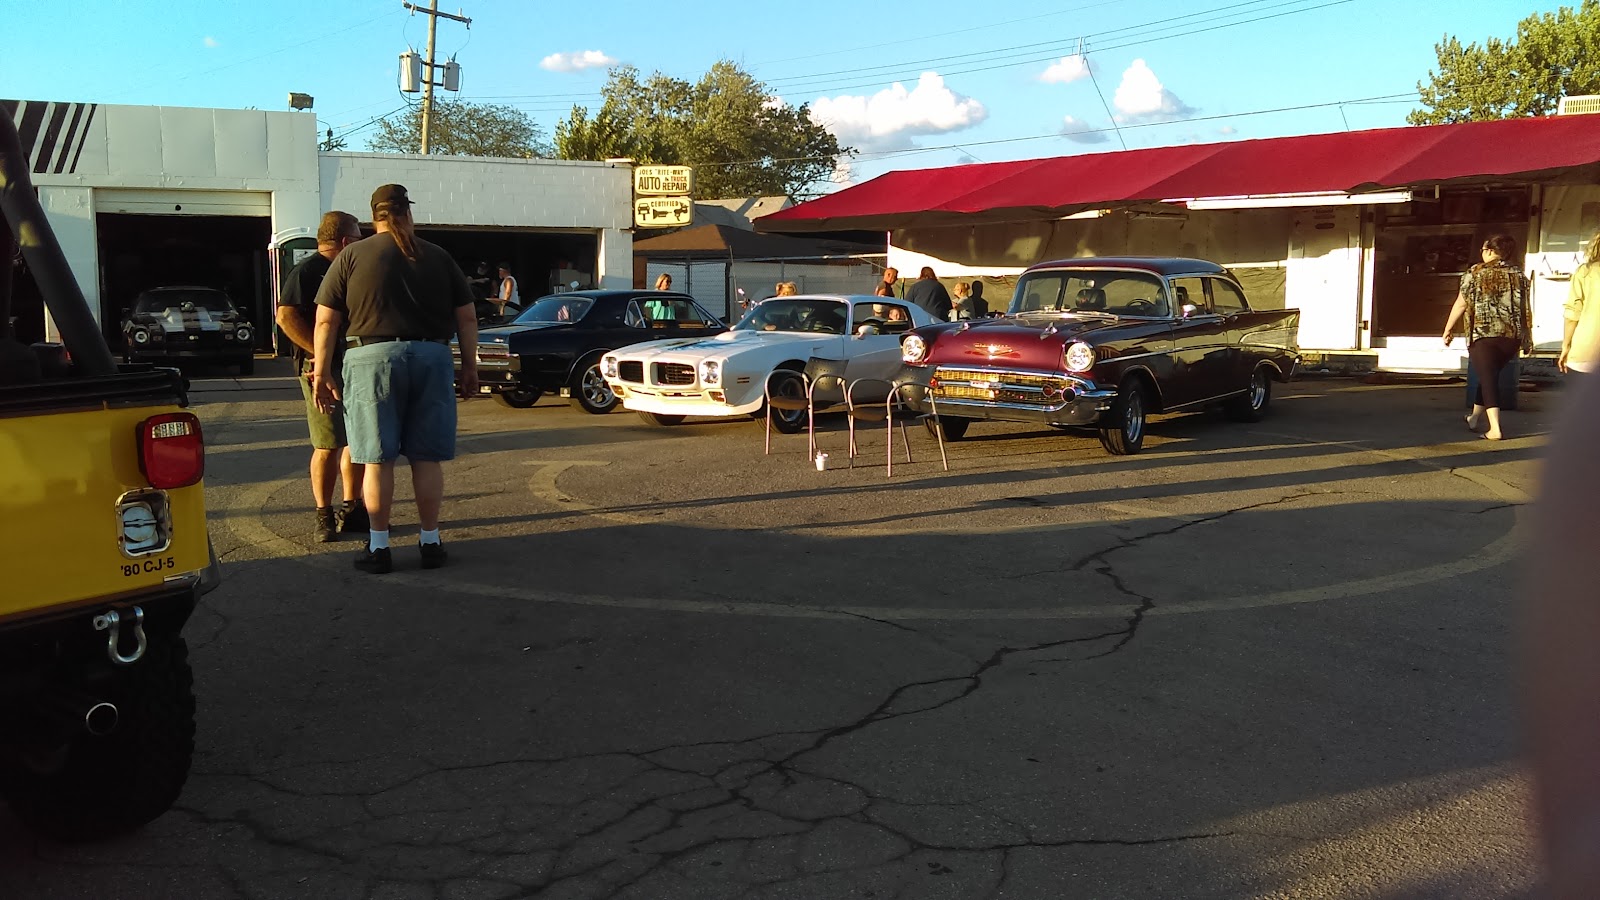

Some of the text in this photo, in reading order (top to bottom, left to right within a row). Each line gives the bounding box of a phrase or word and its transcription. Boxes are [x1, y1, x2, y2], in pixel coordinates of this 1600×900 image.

[638, 176, 661, 190] AUTO
[662, 182, 688, 191] REPAIR
[120, 563, 140, 576] '80
